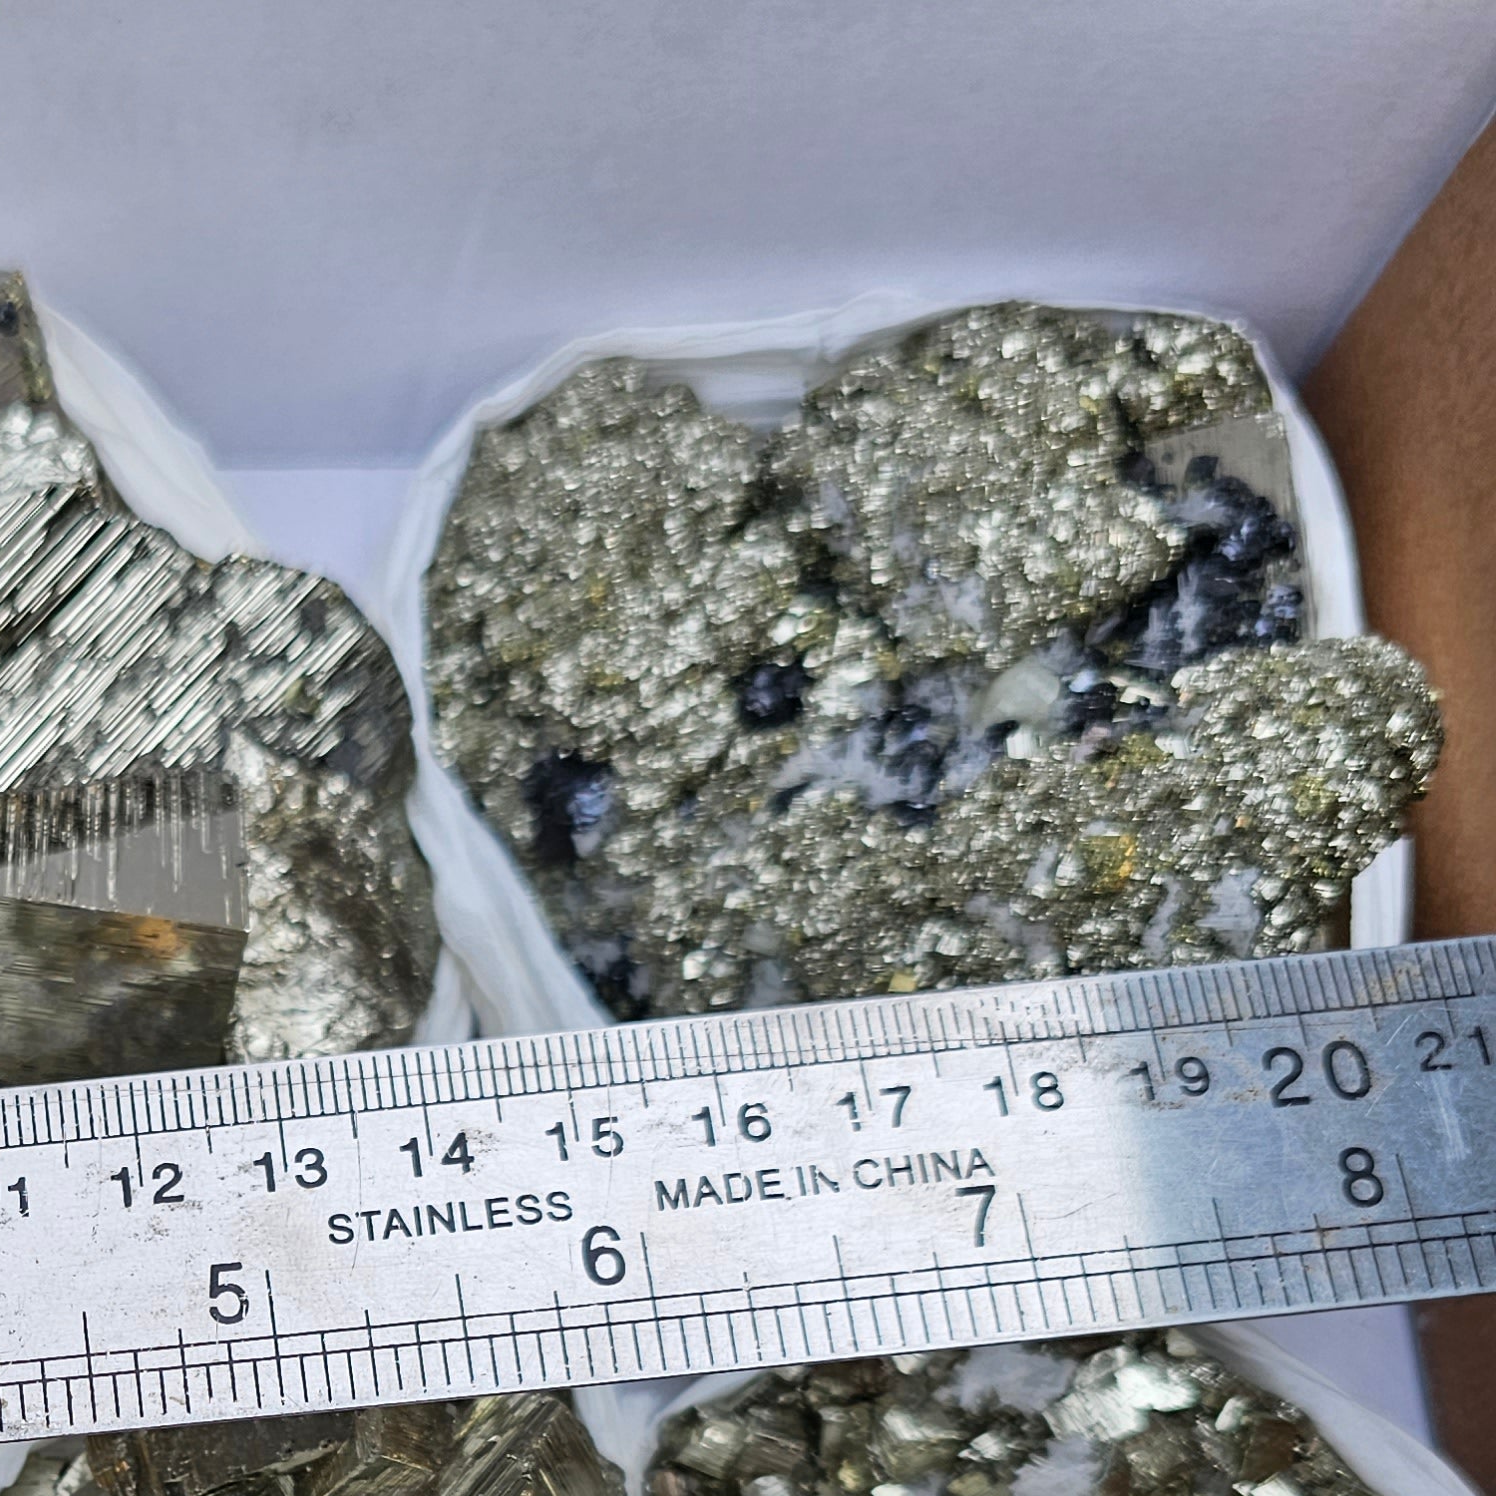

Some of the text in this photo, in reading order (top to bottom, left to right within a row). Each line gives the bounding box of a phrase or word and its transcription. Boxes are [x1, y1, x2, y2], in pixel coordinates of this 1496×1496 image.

[111, 1162, 185, 1208] 12
[253, 1147, 327, 1192] 13
[400, 1131, 475, 1178] 14
[546, 1116, 624, 1161] 15
[691, 1102, 773, 1147] 16
[836, 1085, 913, 1132] 17
[984, 1071, 1064, 1117] 18
[1122, 1056, 1210, 1101] 19
[1261, 1039, 1373, 1108] 20
[1415, 1026, 1491, 1072] 21
[208, 1261, 249, 1325] 5
[581, 1225, 626, 1286] 6
[955, 1184, 996, 1248] 7
[1339, 1147, 1384, 1208] 8
[328, 1191, 574, 1245] STAINLESS
[654, 1148, 996, 1212] MADE IN CHINA
